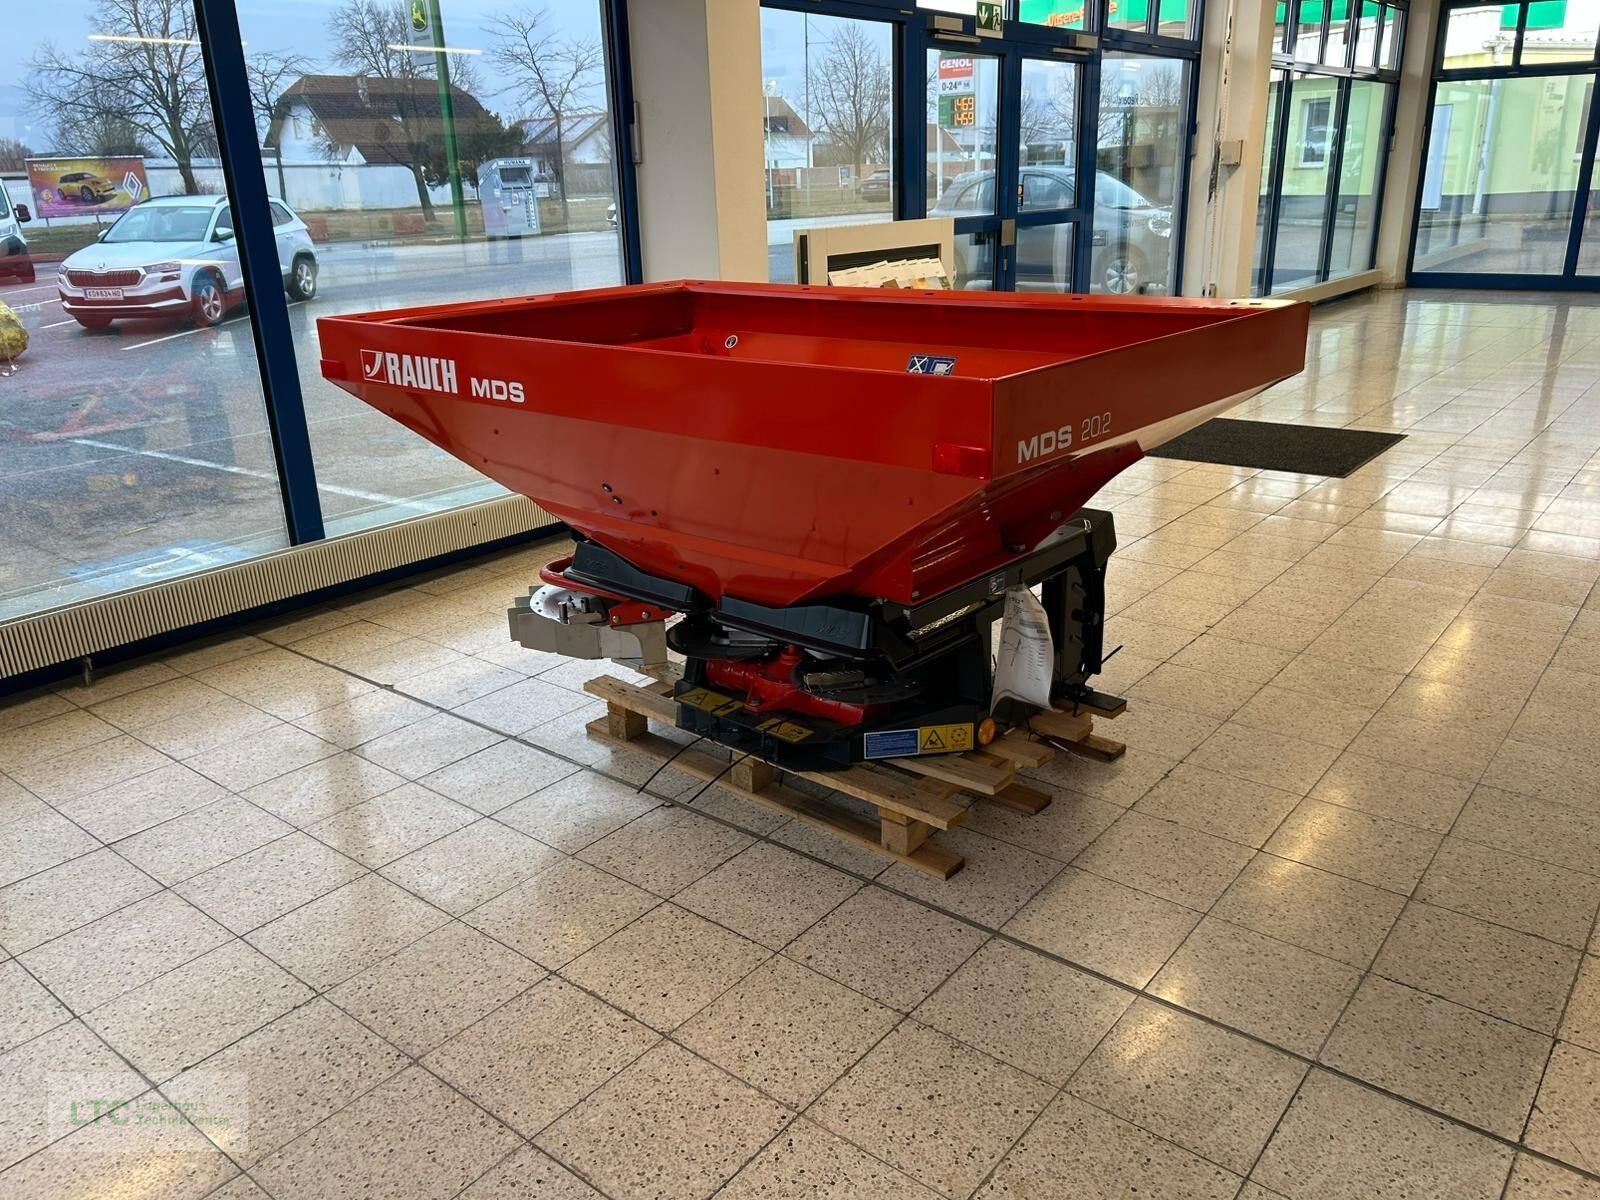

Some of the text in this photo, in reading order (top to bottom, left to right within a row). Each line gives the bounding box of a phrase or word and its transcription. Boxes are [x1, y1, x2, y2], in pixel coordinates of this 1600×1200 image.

[940, 58, 972, 69] GENOL
[385, 352, 459, 394] RAUCH
[470, 377, 525, 403] MDS
[1017, 424, 1073, 465] MDS
